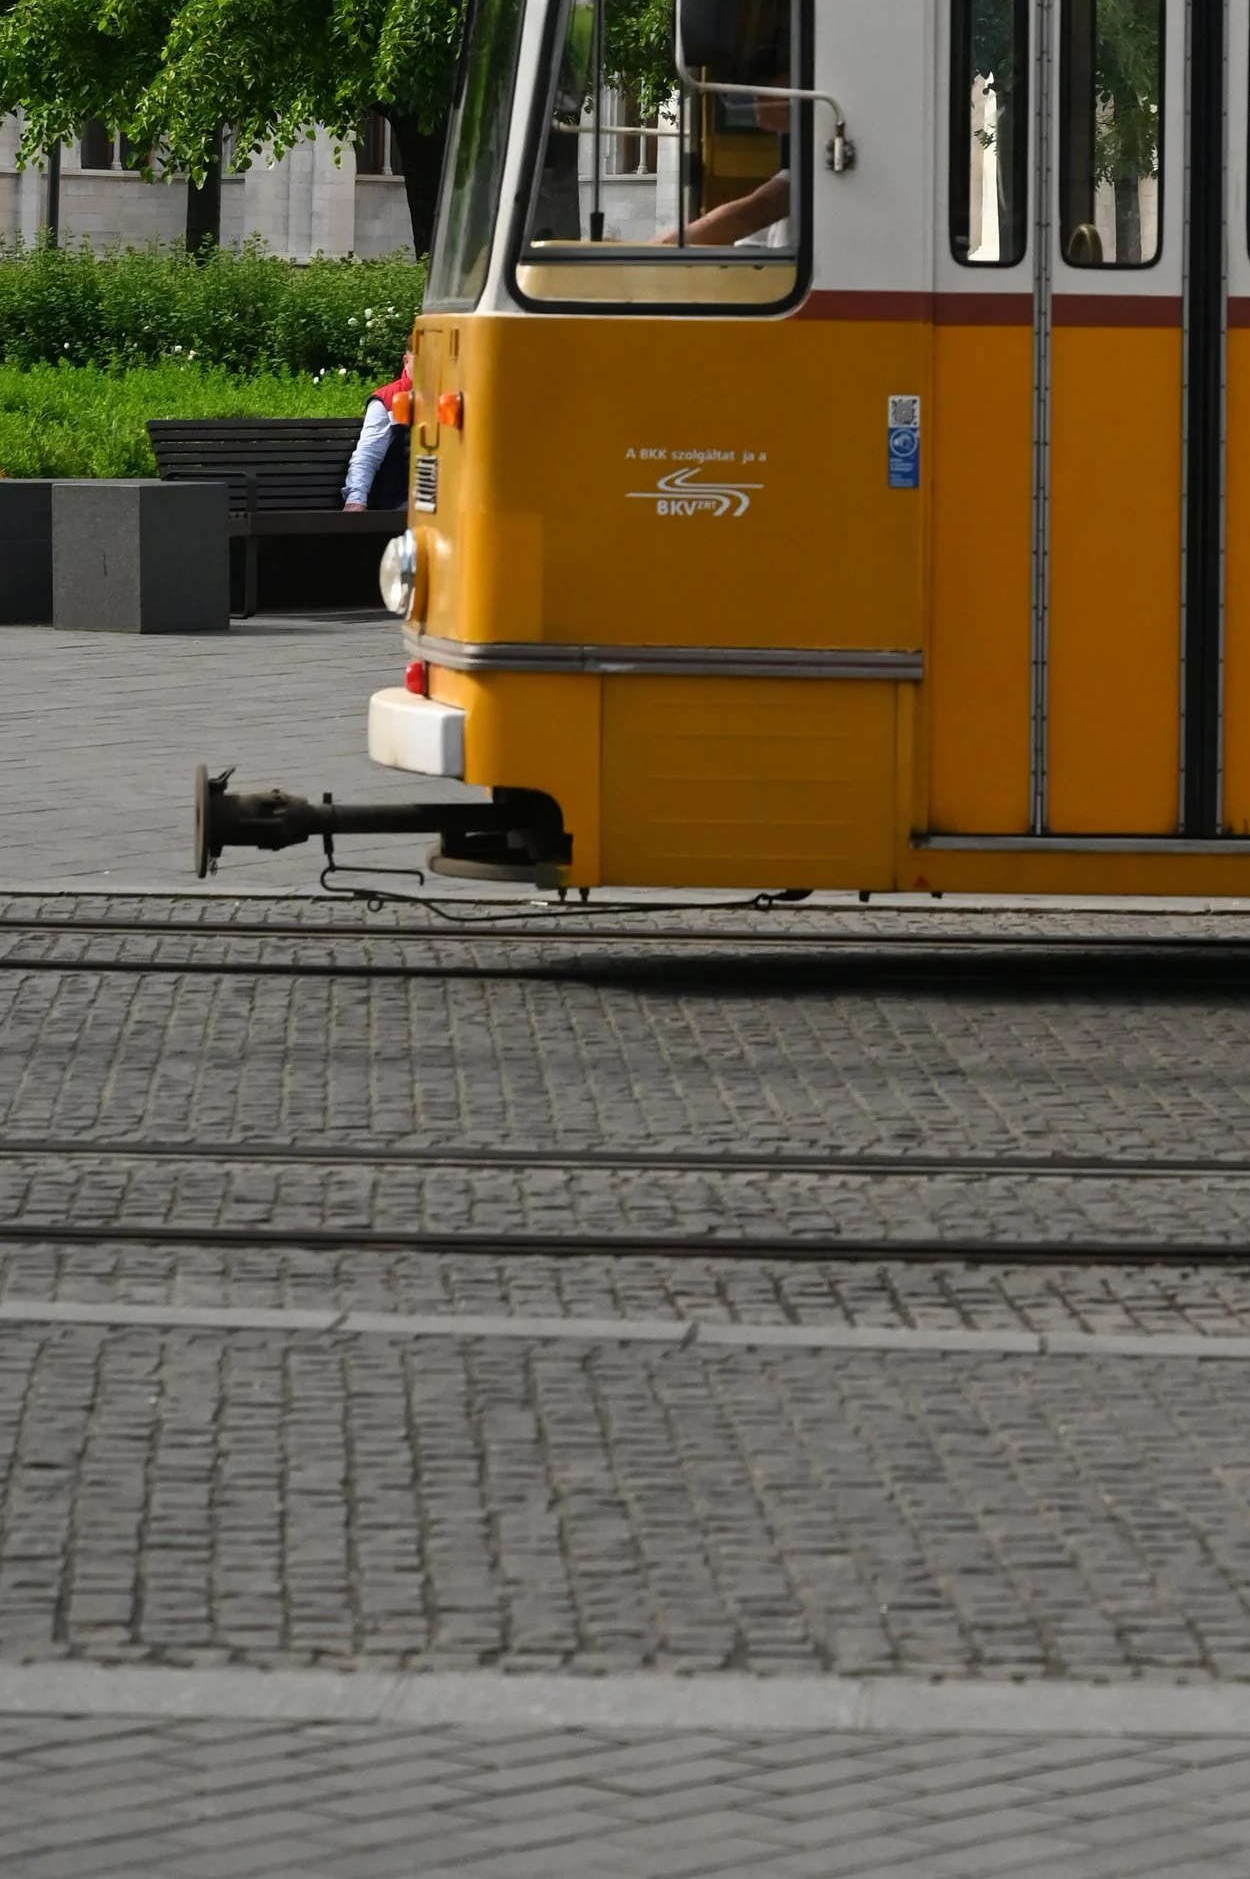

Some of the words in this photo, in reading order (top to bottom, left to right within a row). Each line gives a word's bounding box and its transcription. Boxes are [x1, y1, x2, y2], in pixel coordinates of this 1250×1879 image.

[626, 448, 636, 459] A
[640, 448, 667, 459] BKK
[656, 499, 696, 516] BKV
